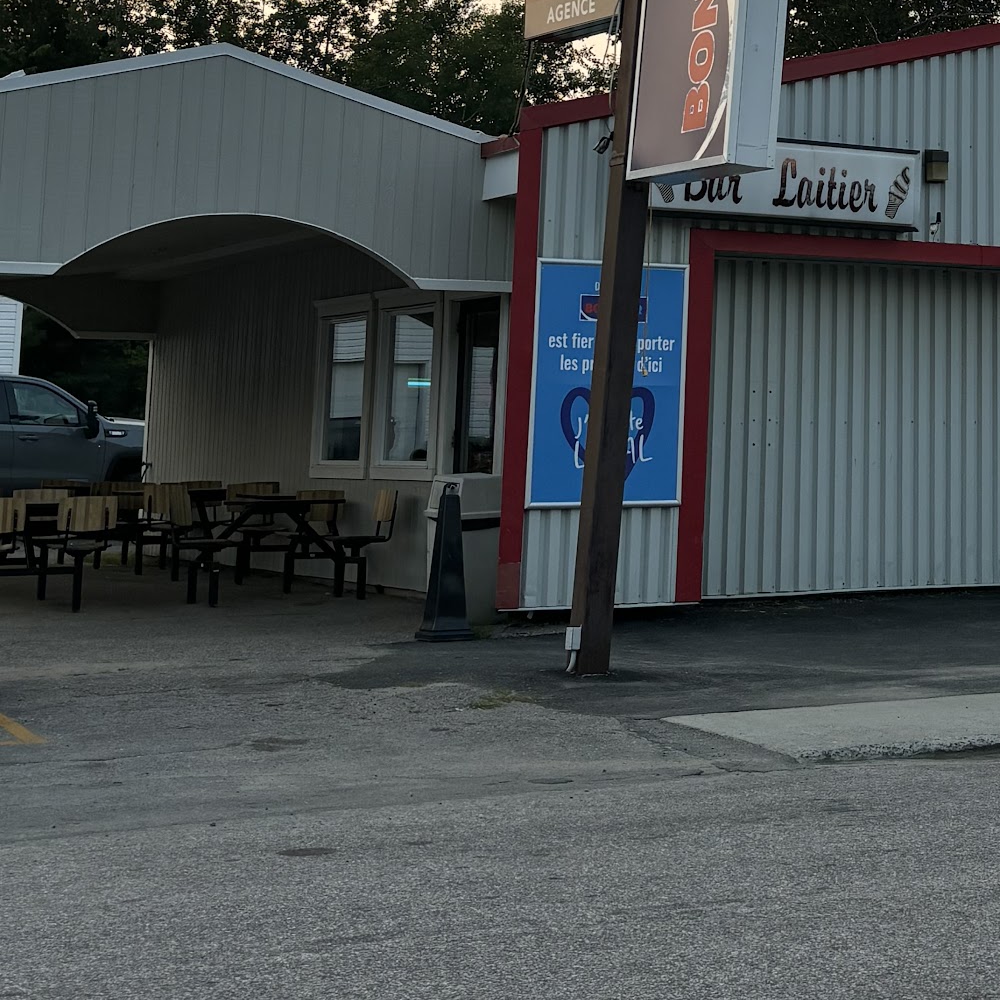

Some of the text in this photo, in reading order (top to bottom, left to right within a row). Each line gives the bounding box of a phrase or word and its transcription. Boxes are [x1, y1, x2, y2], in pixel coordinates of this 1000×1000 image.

[772, 157, 878, 213] Laitier
[548, 333, 568, 349] est
[571, 333, 595, 350] fier
[559, 354, 579, 372] les
